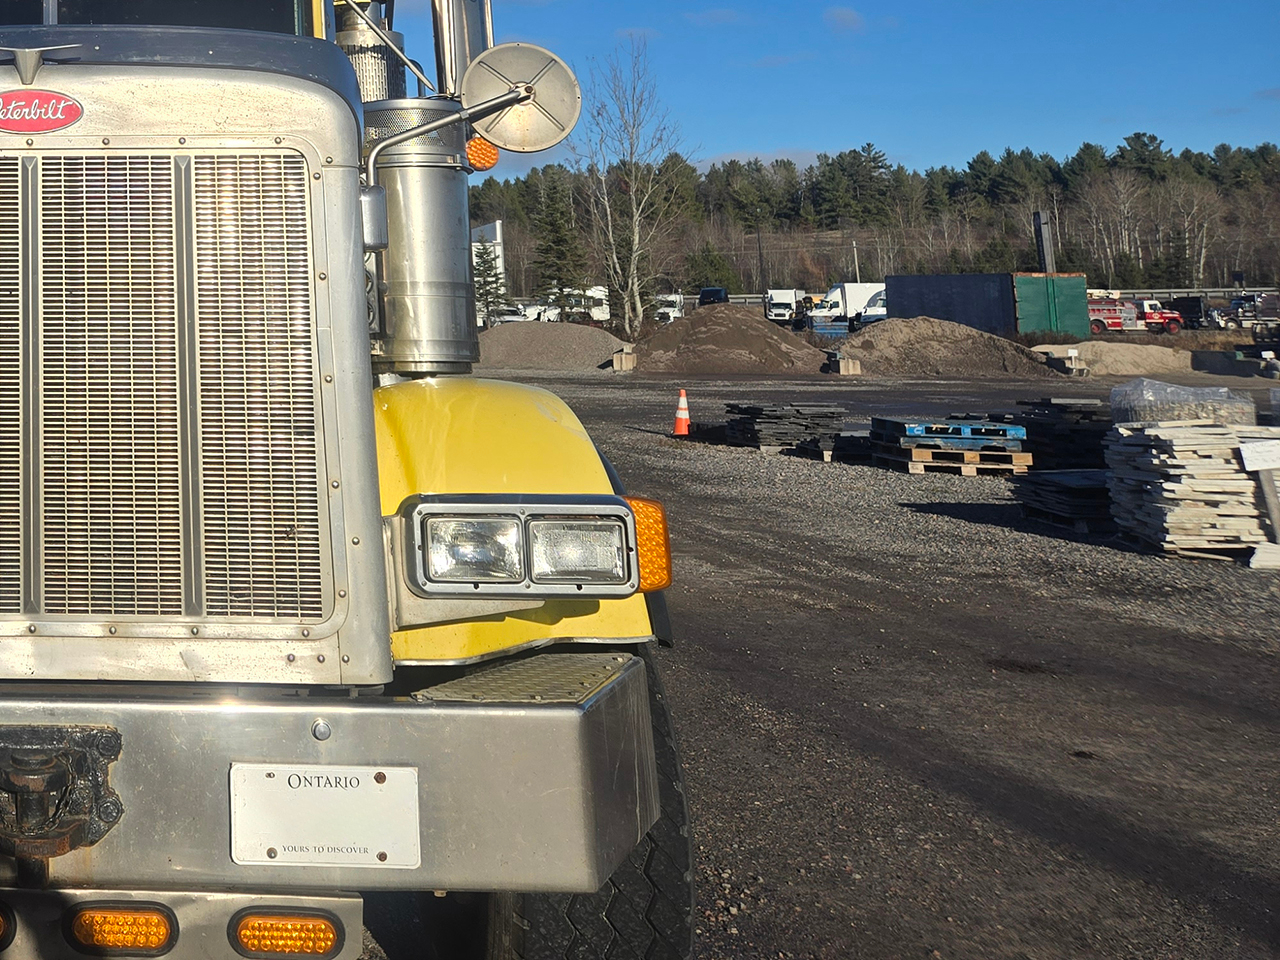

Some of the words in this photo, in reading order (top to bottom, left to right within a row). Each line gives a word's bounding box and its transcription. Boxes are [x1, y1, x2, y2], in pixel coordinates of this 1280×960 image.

[287, 773, 360, 790] ONTARIO
[282, 845, 310, 853] YOURS
[313, 846, 325, 854] TO
[327, 846, 369, 854] DISCOVER
